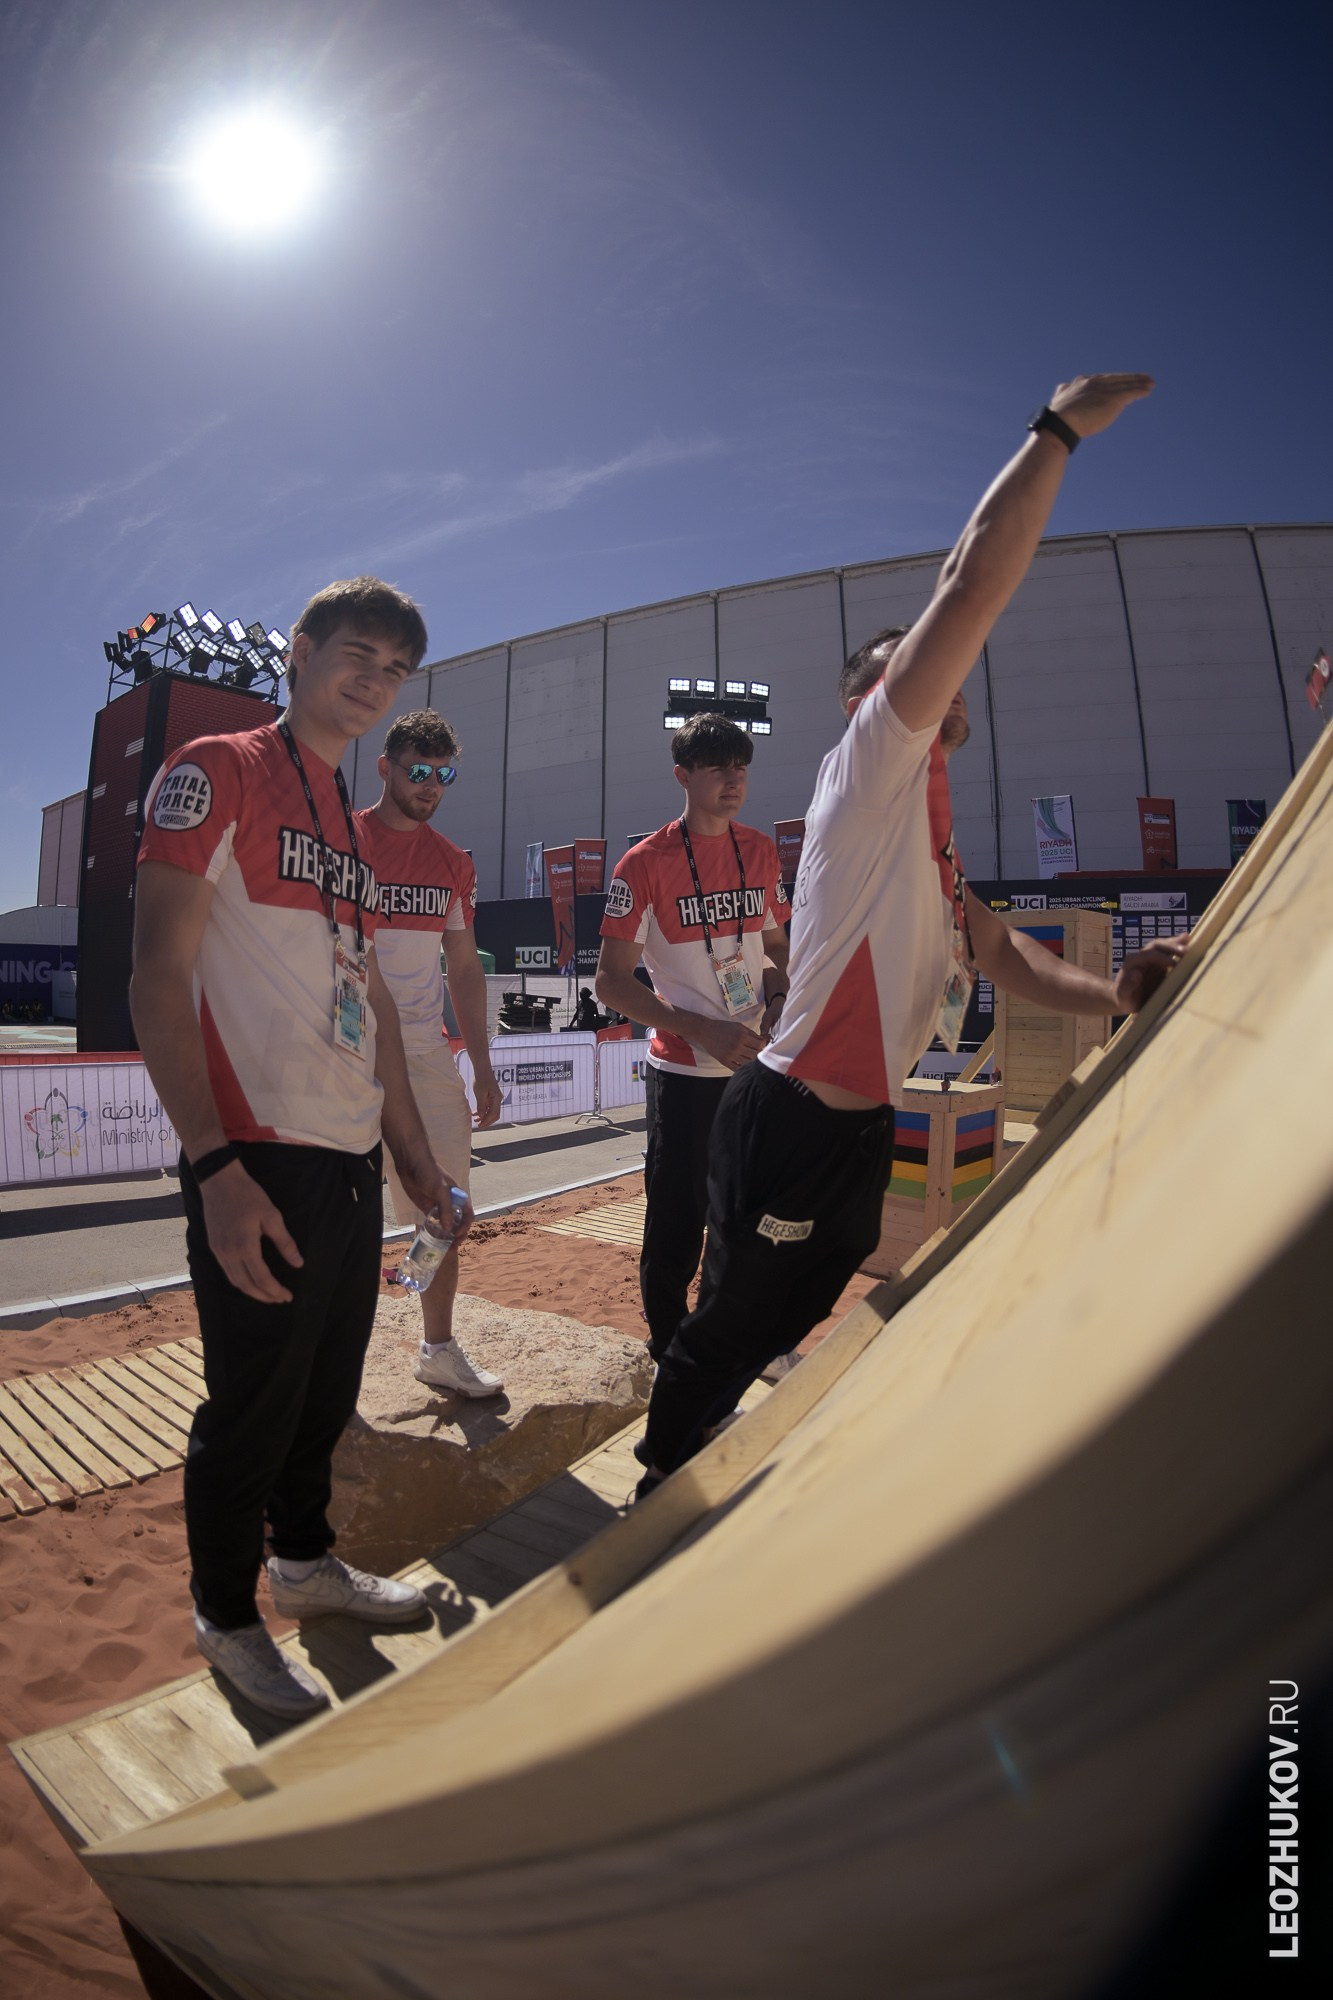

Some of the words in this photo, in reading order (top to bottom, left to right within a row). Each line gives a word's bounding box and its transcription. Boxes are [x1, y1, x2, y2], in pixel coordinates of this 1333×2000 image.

[163, 774, 208, 796] TRIAL
[156, 793, 205, 815] FORCE
[1040, 839, 1072, 849] RIYADH
[1041, 849, 1059, 857] 2025
[610, 885, 631, 898] RIAL
[1016, 898, 1044, 910] UCI
[522, 950, 548, 964] UCI
[103, 1125, 154, 1146] Ministry
[158, 1126, 173, 1142] of
